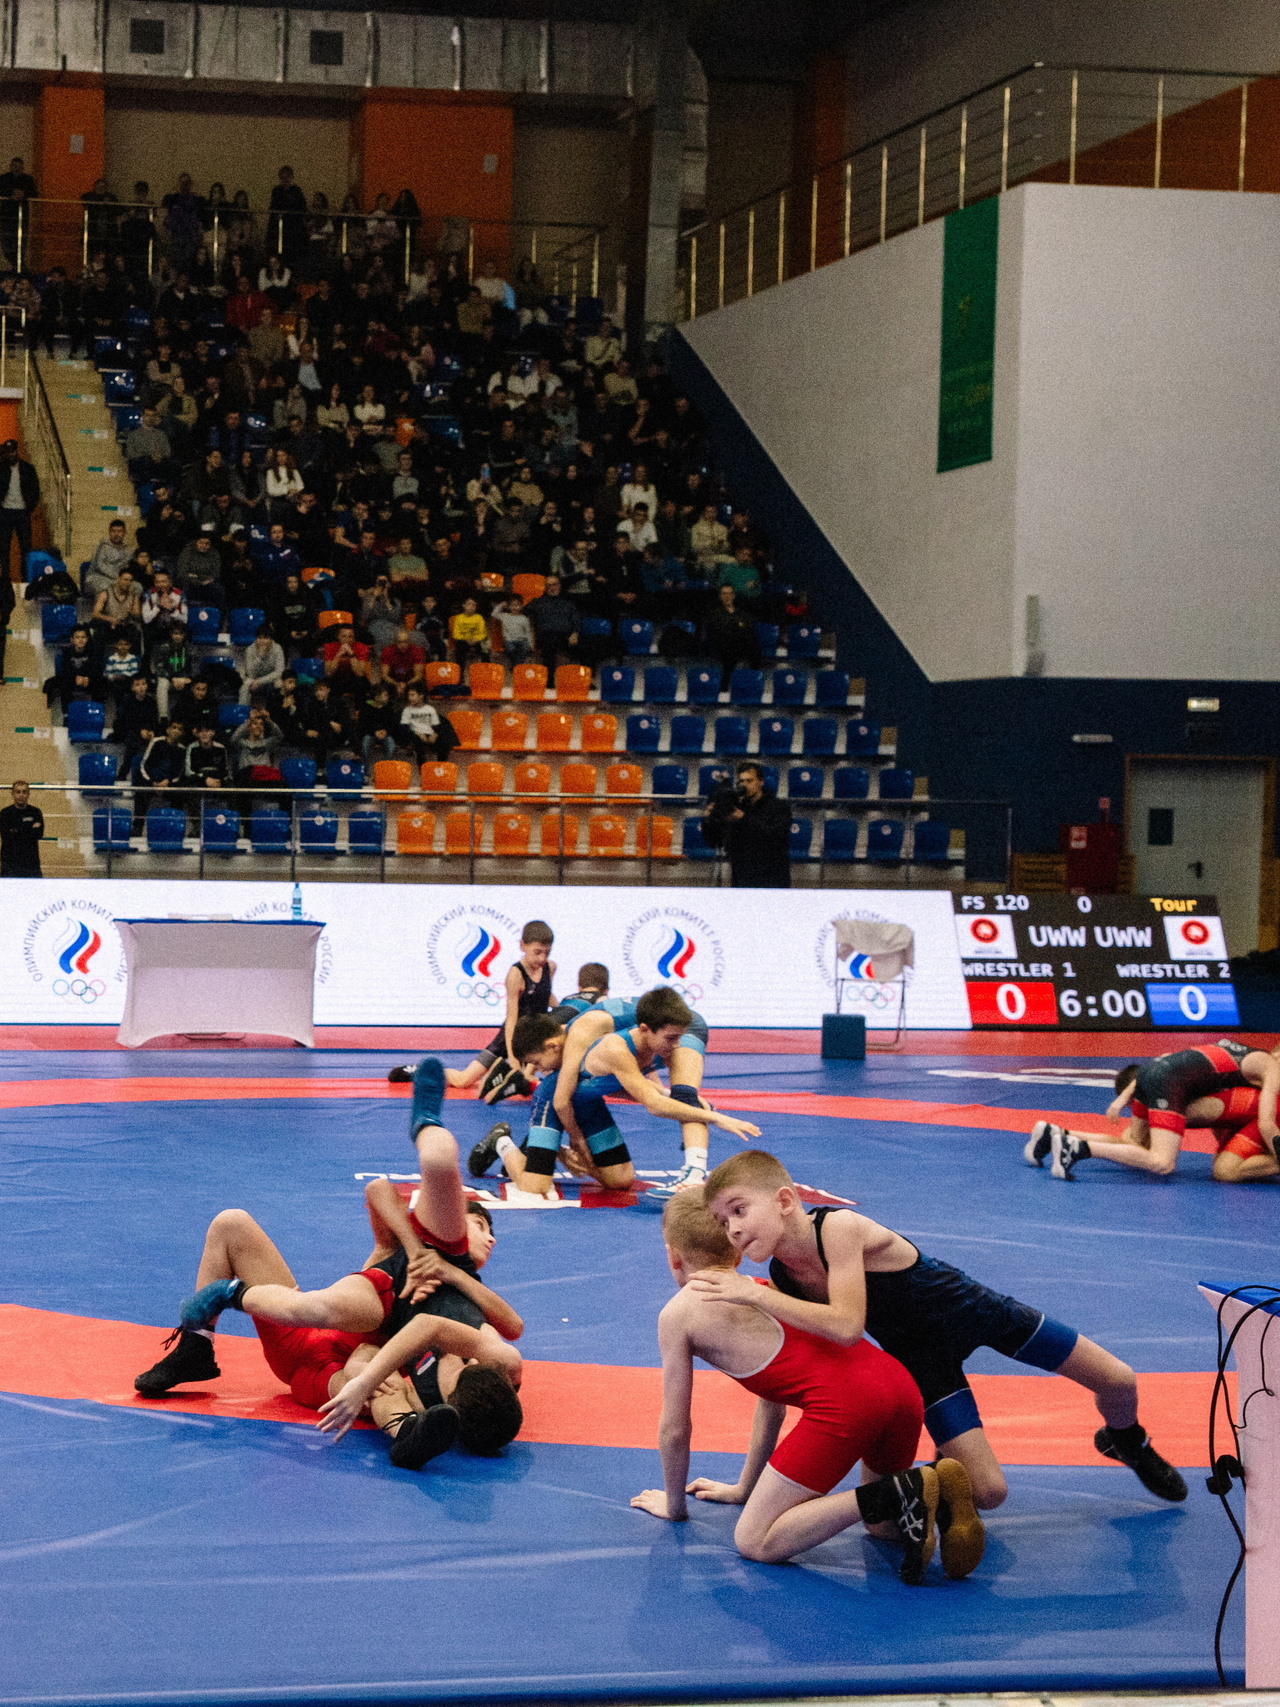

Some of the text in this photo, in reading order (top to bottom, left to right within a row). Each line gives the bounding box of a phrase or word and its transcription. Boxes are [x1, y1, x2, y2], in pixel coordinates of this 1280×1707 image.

[961, 895, 1029, 911] FS 120
[1077, 896, 1092, 913] 0
[1150, 898, 1197, 912] Tour
[470, 905, 520, 936] КОМИТЕТ
[23, 899, 67, 982] ОЛИМПИЙСКИЙ
[71, 899, 117, 930] КОМИТ
[1028, 925, 1152, 948] UWW UWW
[962, 962, 1076, 978] WRESTLER 1
[1116, 963, 1230, 978] WRESTLER 2
[996, 983, 1026, 1020] 0
[1059, 989, 1146, 1017] 6:00
[1178, 985, 1208, 1021] 0
